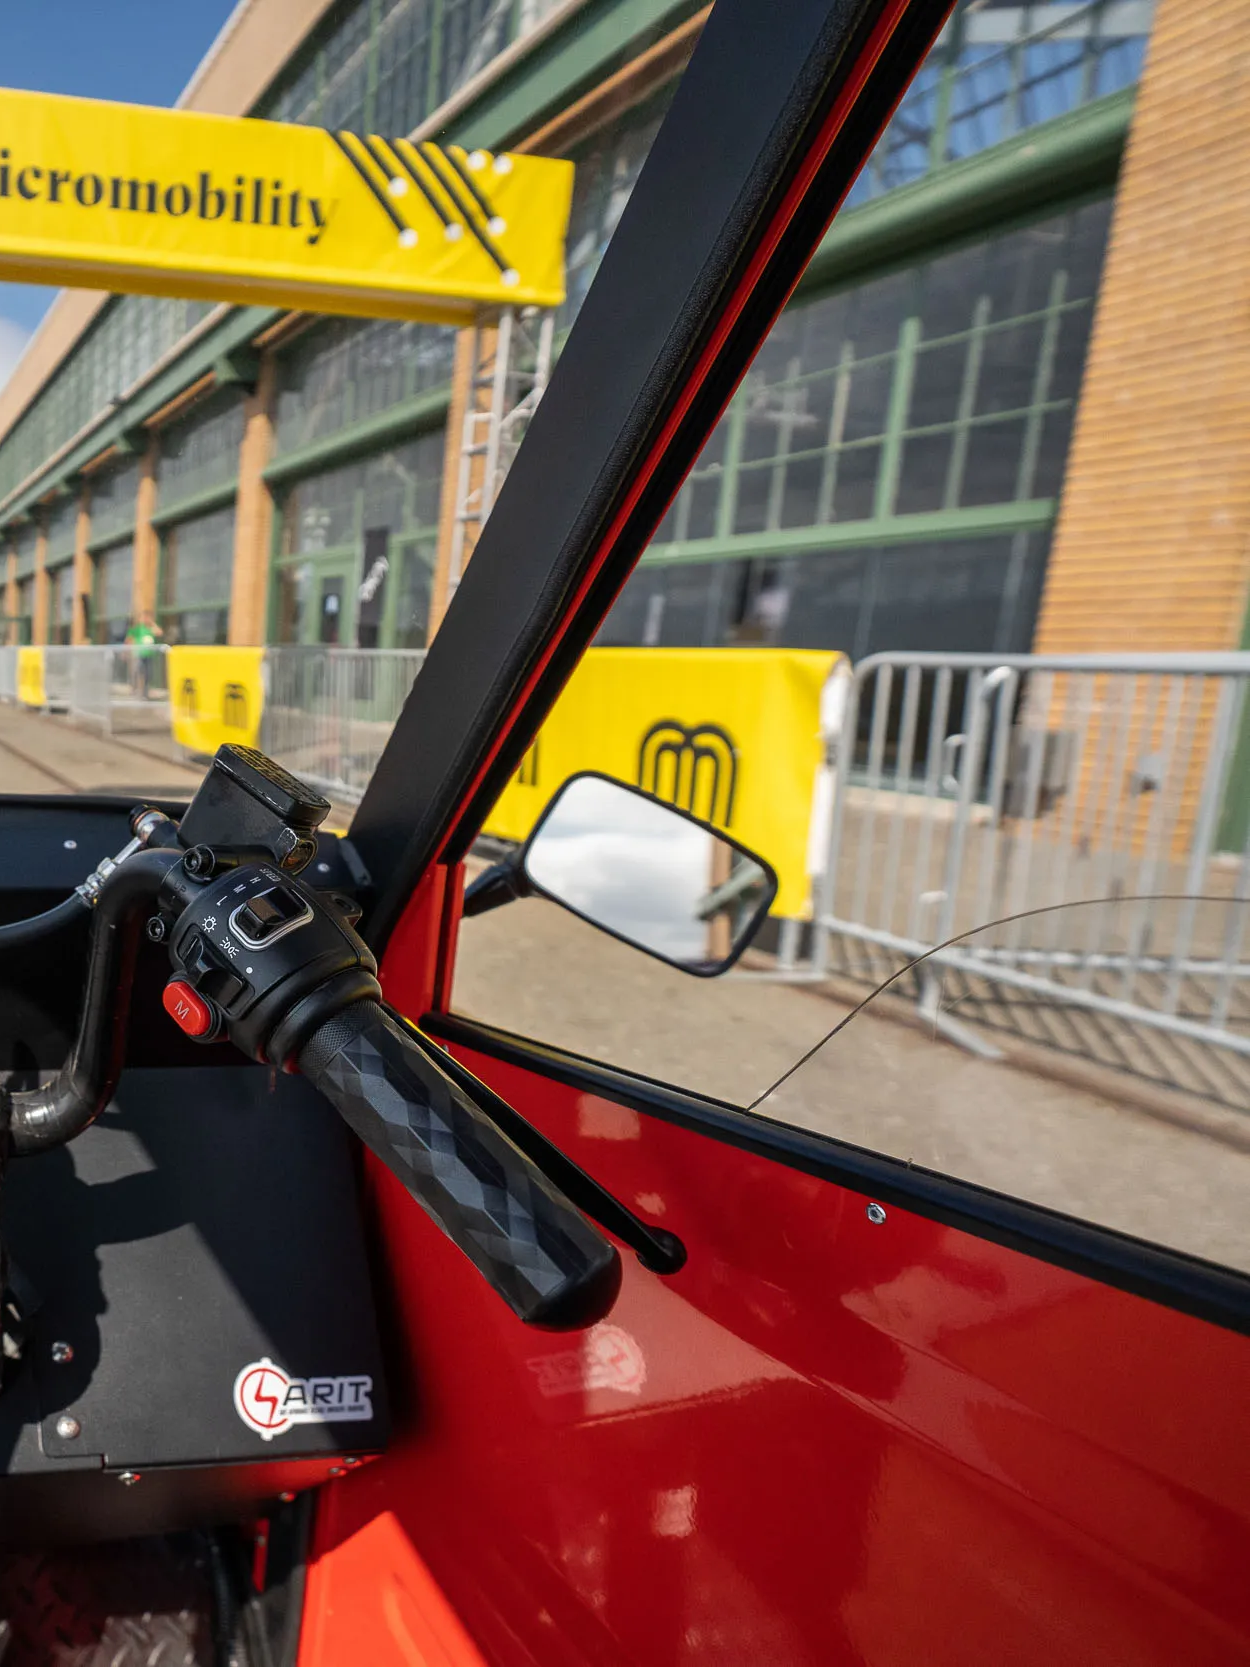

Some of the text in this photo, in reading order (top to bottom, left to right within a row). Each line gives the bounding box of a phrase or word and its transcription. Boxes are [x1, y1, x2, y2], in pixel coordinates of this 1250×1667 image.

[249, 876, 262, 884] H
[233, 884, 247, 894] M
[174, 1000, 190, 1020] M
